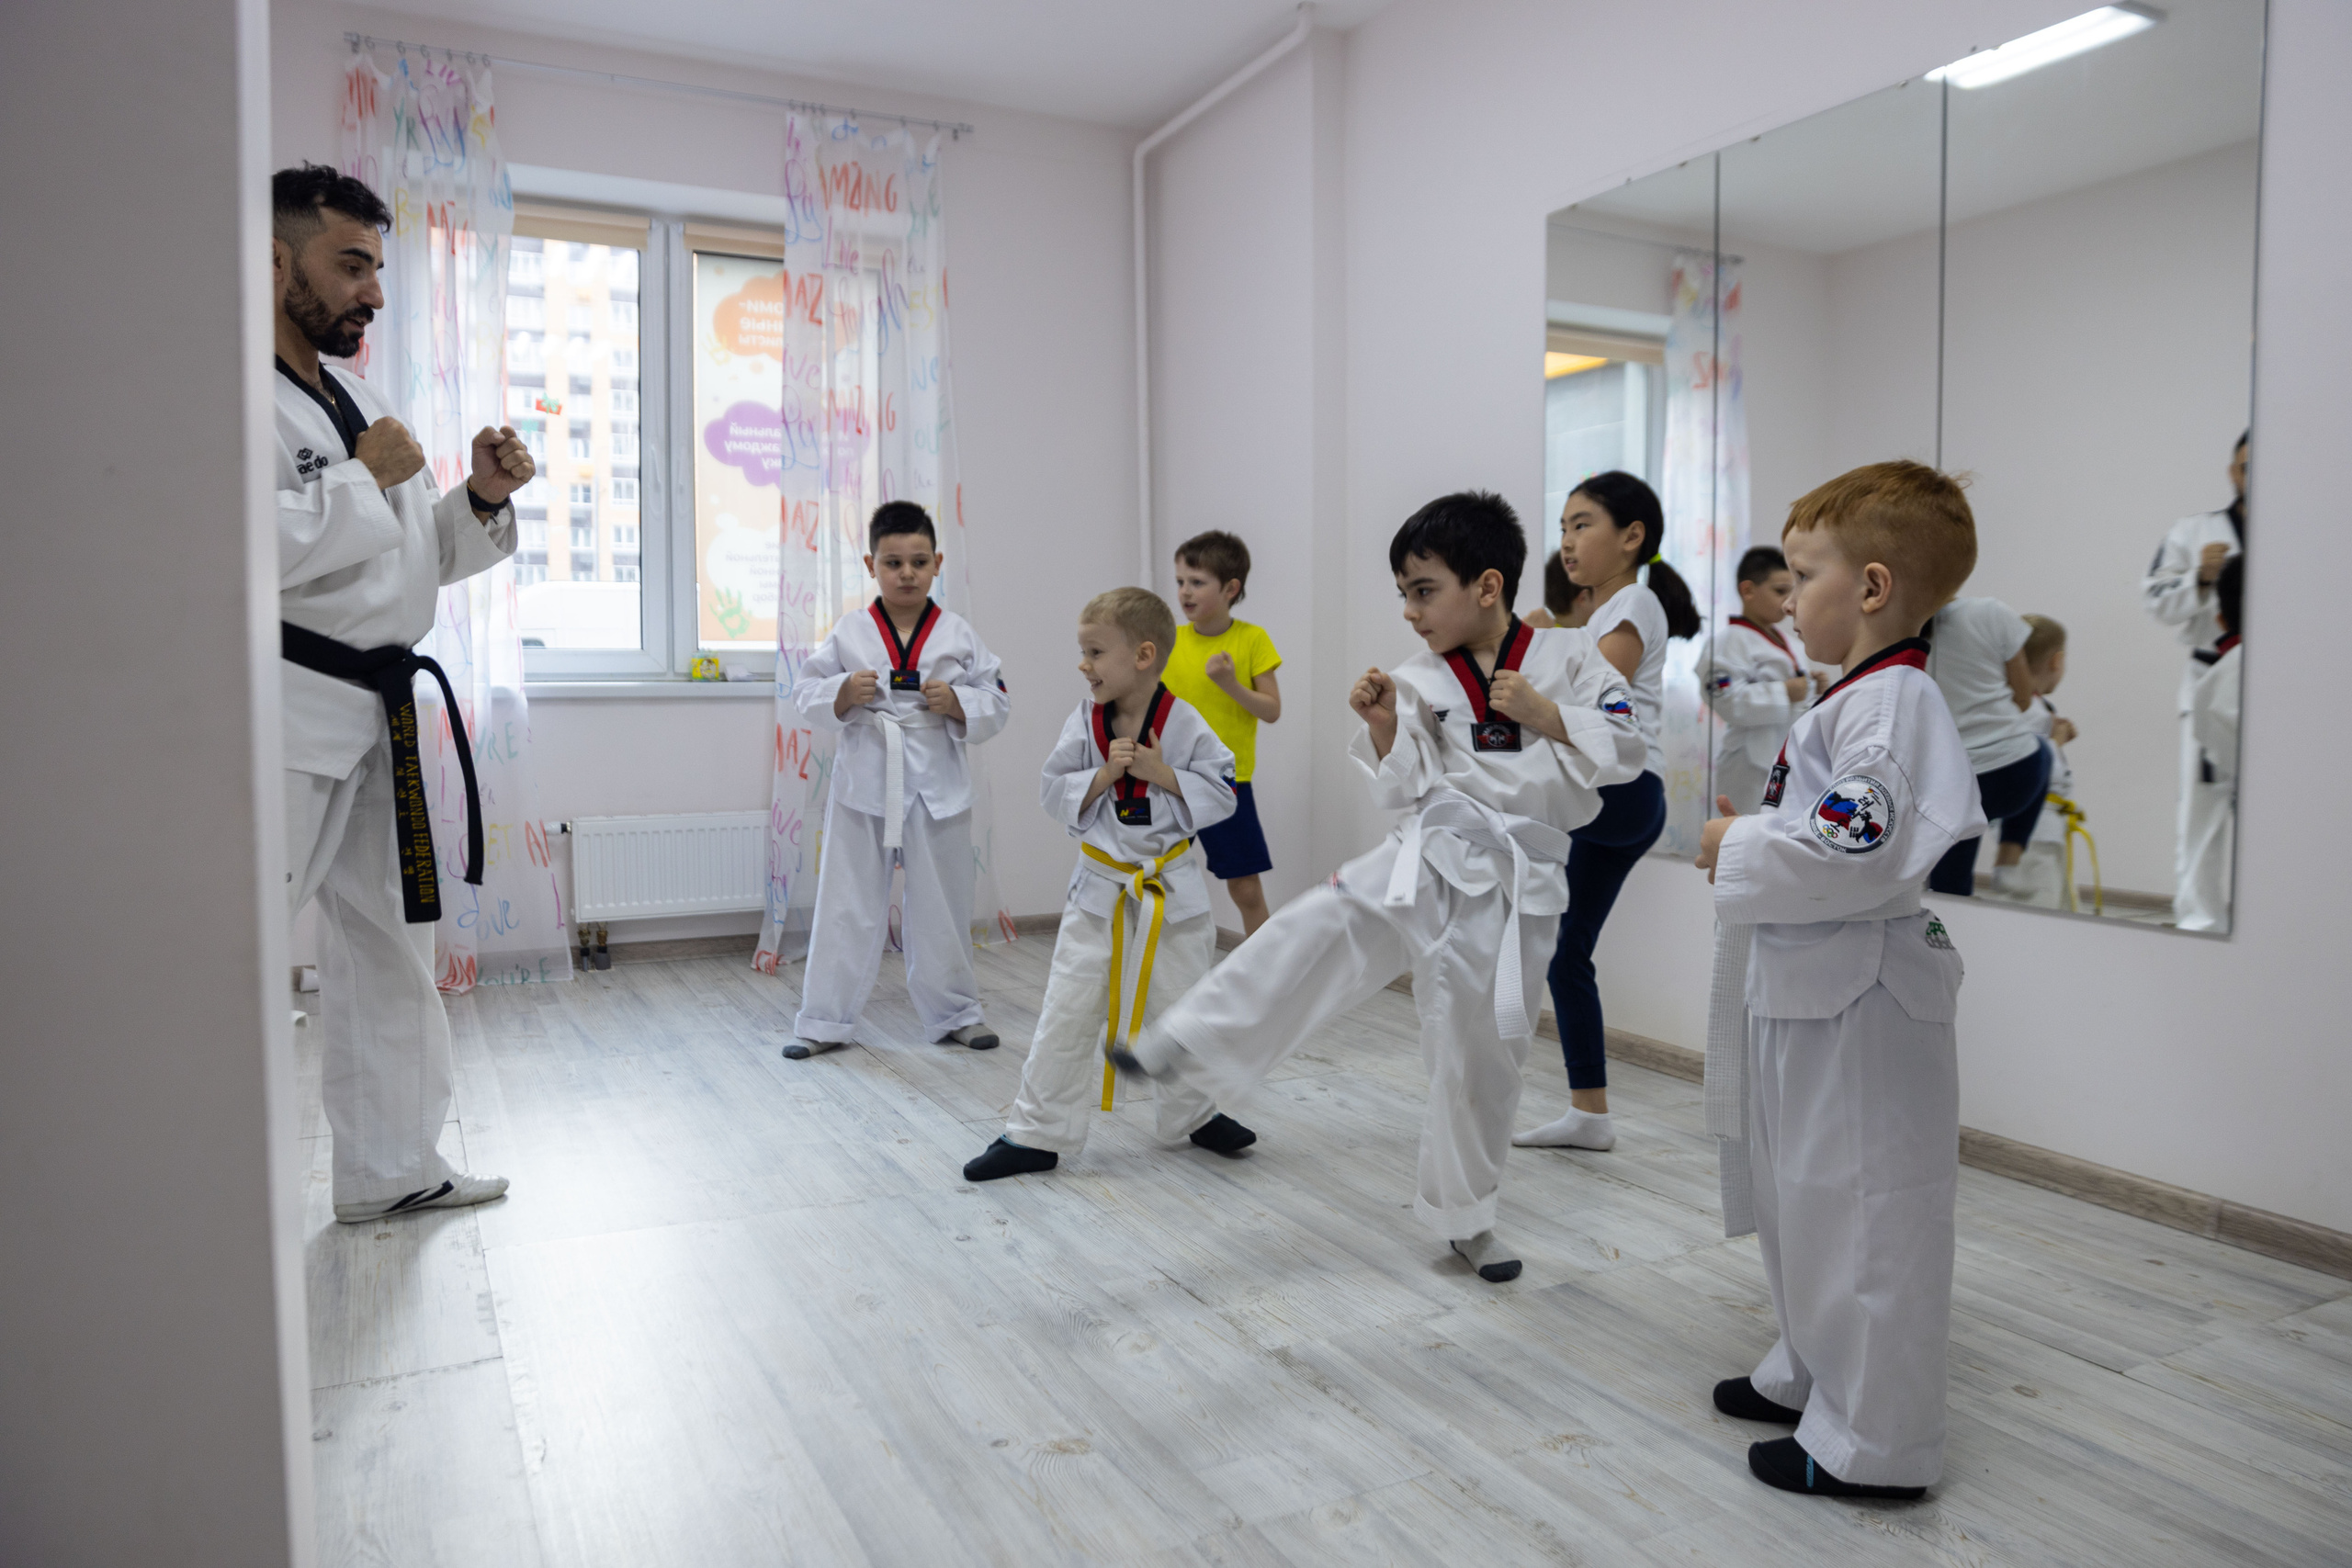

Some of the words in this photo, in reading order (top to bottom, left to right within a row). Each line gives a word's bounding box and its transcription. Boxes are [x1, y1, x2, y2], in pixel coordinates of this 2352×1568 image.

[297, 455, 329, 475] aedo
[400, 702, 416, 748] WORLD
[405, 753, 426, 829] TAEKWONDO
[413, 832, 435, 903] FEDERATION
